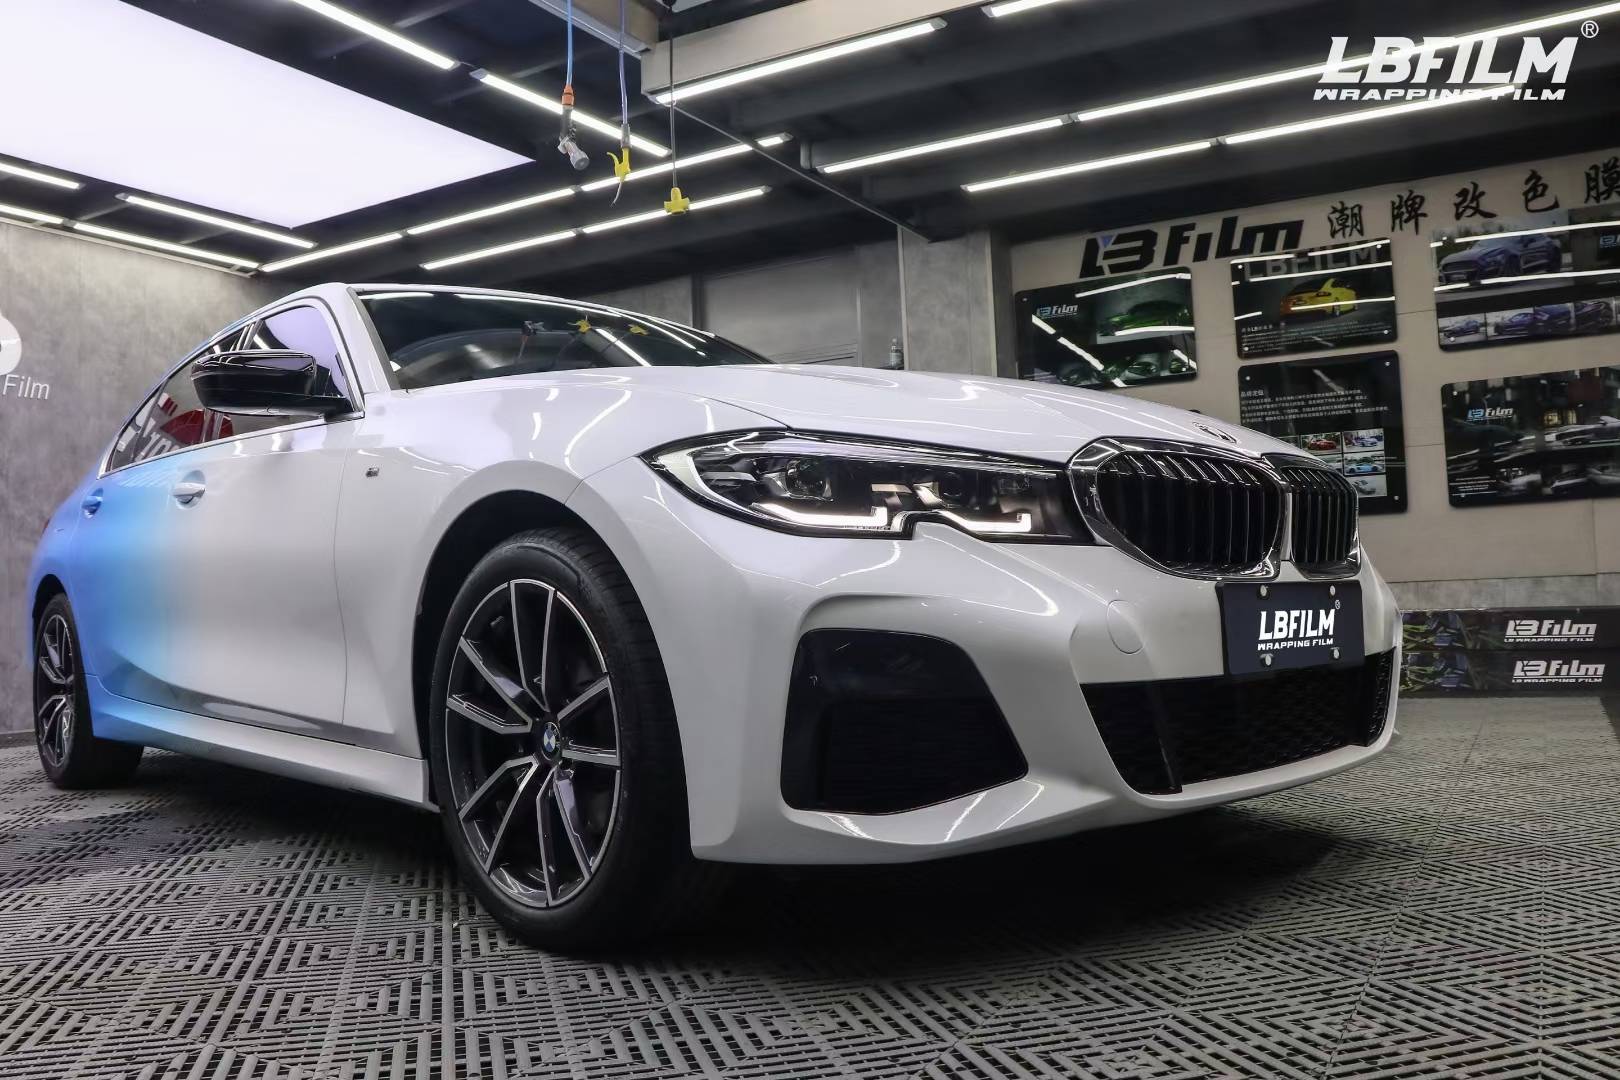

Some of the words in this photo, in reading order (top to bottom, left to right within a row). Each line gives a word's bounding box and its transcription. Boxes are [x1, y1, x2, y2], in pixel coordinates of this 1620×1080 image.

[1327, 157, 1620, 239] 潮牌改色膜
[2, 374, 50, 400] Film
[1259, 609, 1335, 640] LBFILM
[1257, 640, 1310, 651] WRAPPING
[1312, 638, 1334, 646] FILM
